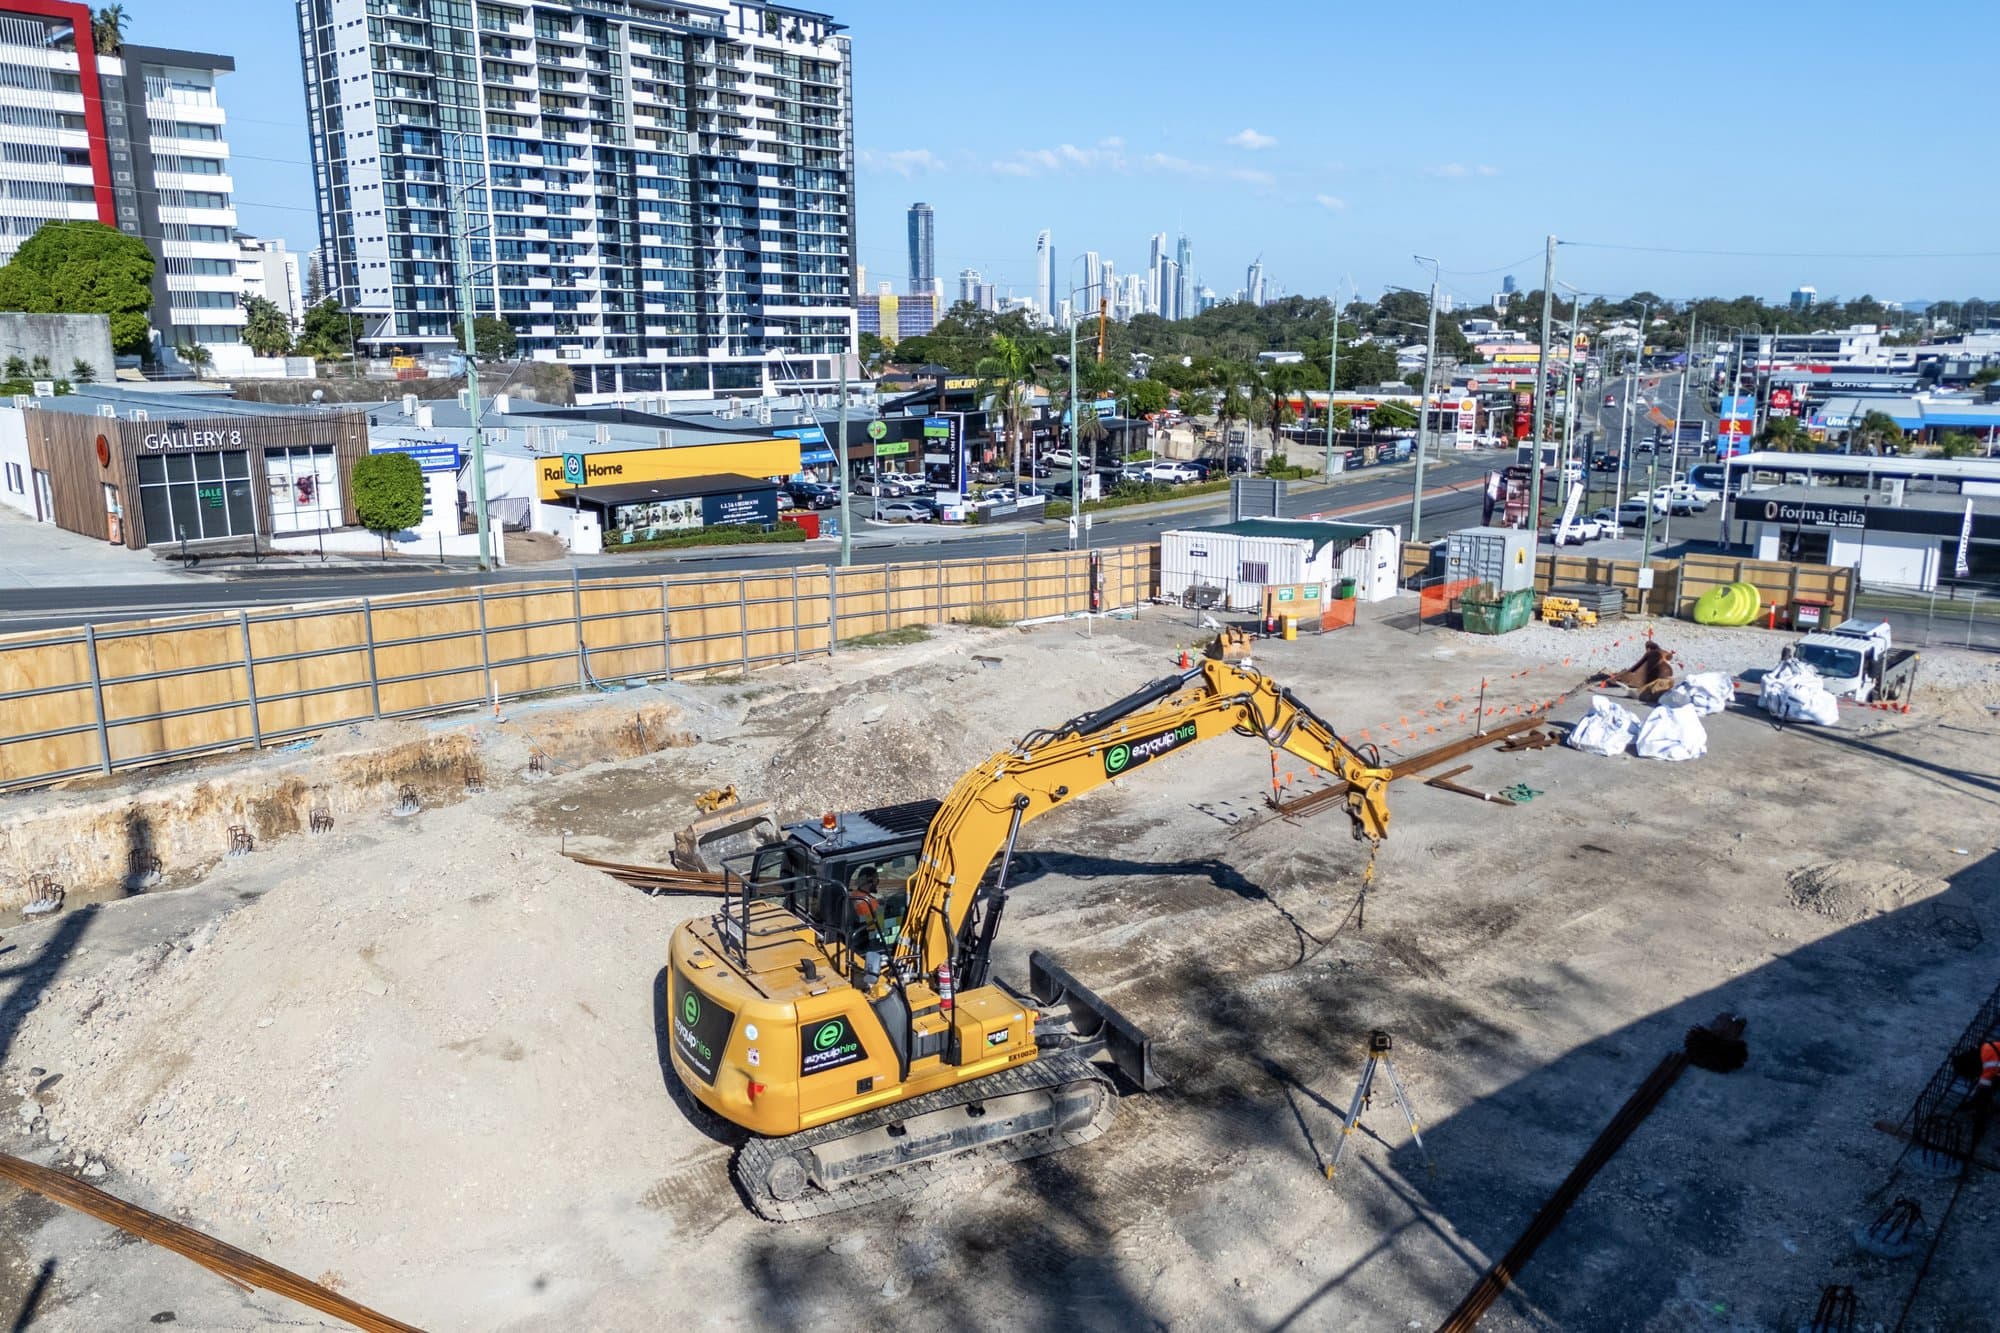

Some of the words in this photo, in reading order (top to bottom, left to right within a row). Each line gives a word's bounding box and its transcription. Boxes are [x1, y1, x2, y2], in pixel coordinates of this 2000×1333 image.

[145, 430, 225, 449] GALLERY
[231, 430, 241, 445] 8
[199, 487, 222, 498] SALE
[1780, 505, 1825, 521] forma
[1828, 508, 1865, 523] italia
[1132, 725, 1195, 757] ezyquiphire
